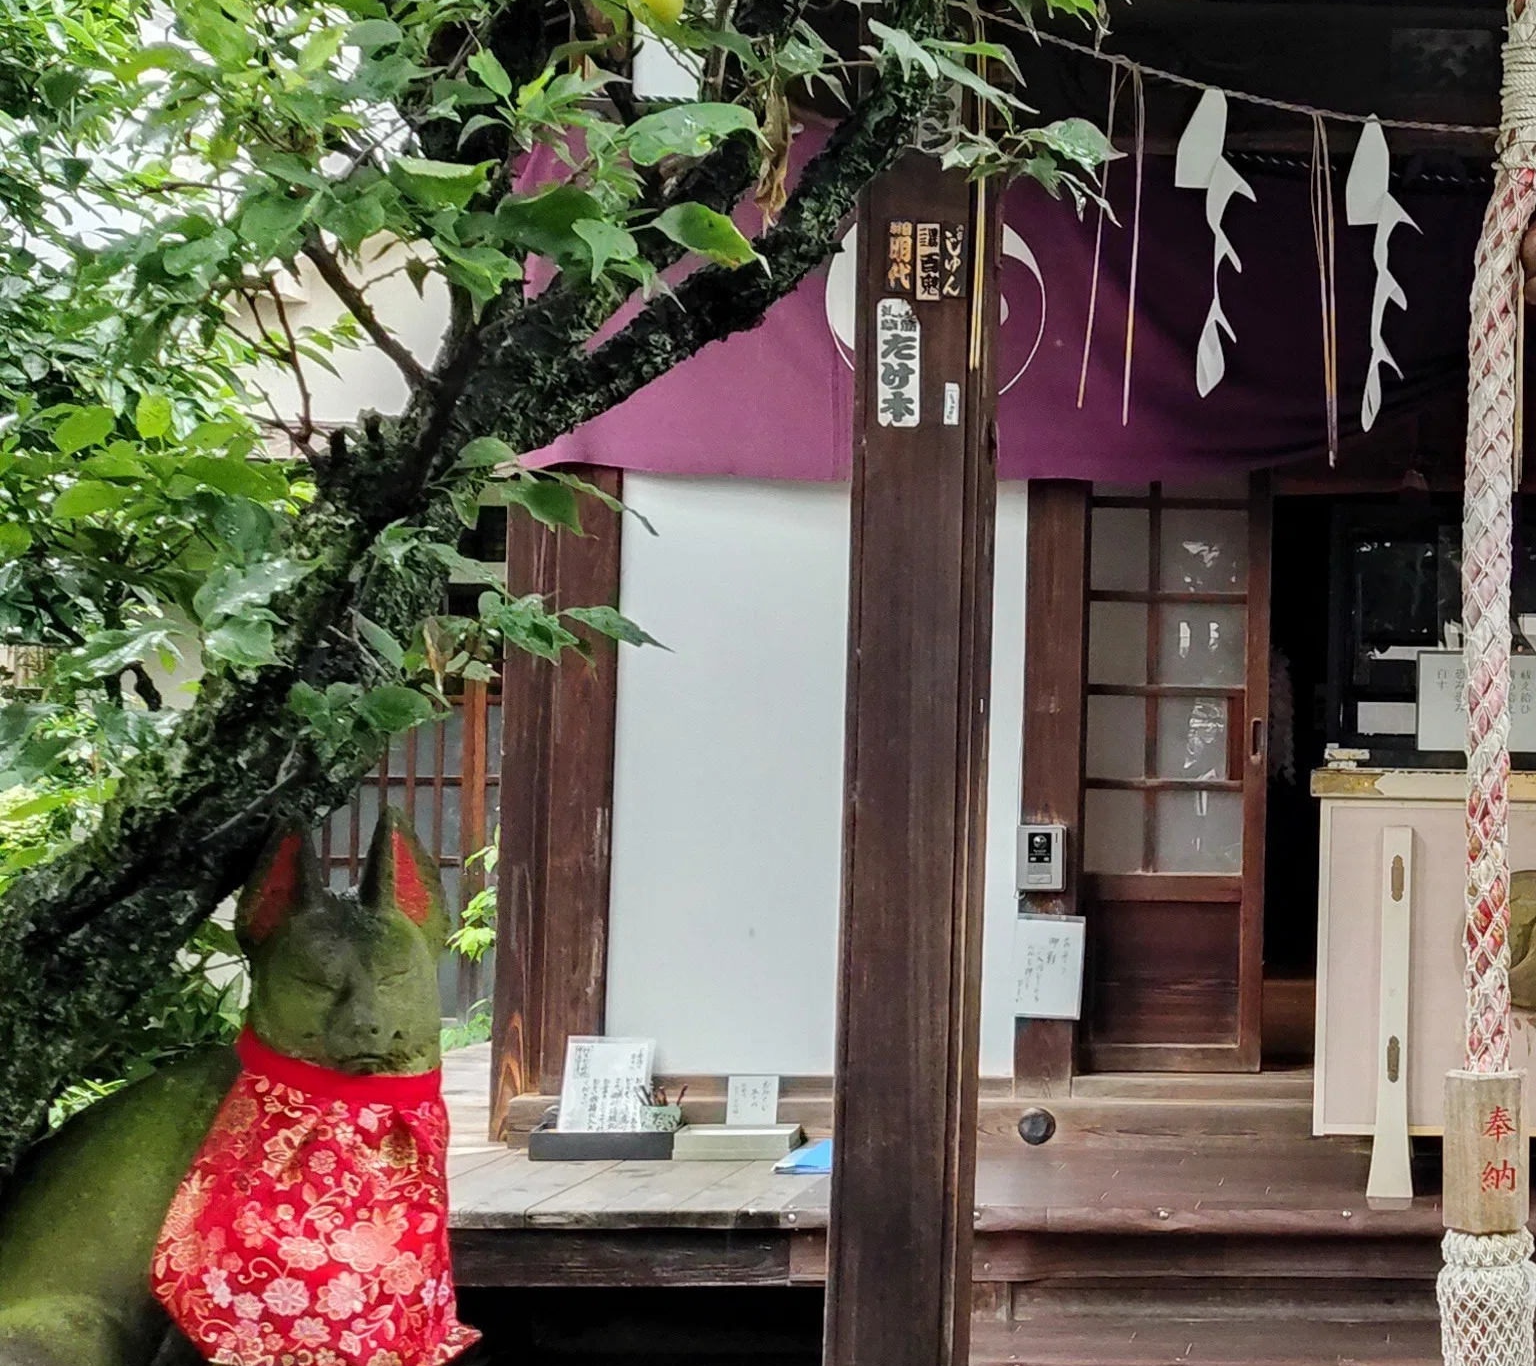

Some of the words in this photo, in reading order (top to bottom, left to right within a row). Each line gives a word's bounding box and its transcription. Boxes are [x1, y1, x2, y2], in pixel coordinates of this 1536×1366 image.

[880, 333, 917, 423] たけ本
[1480, 1105, 1518, 1195] 奉納
